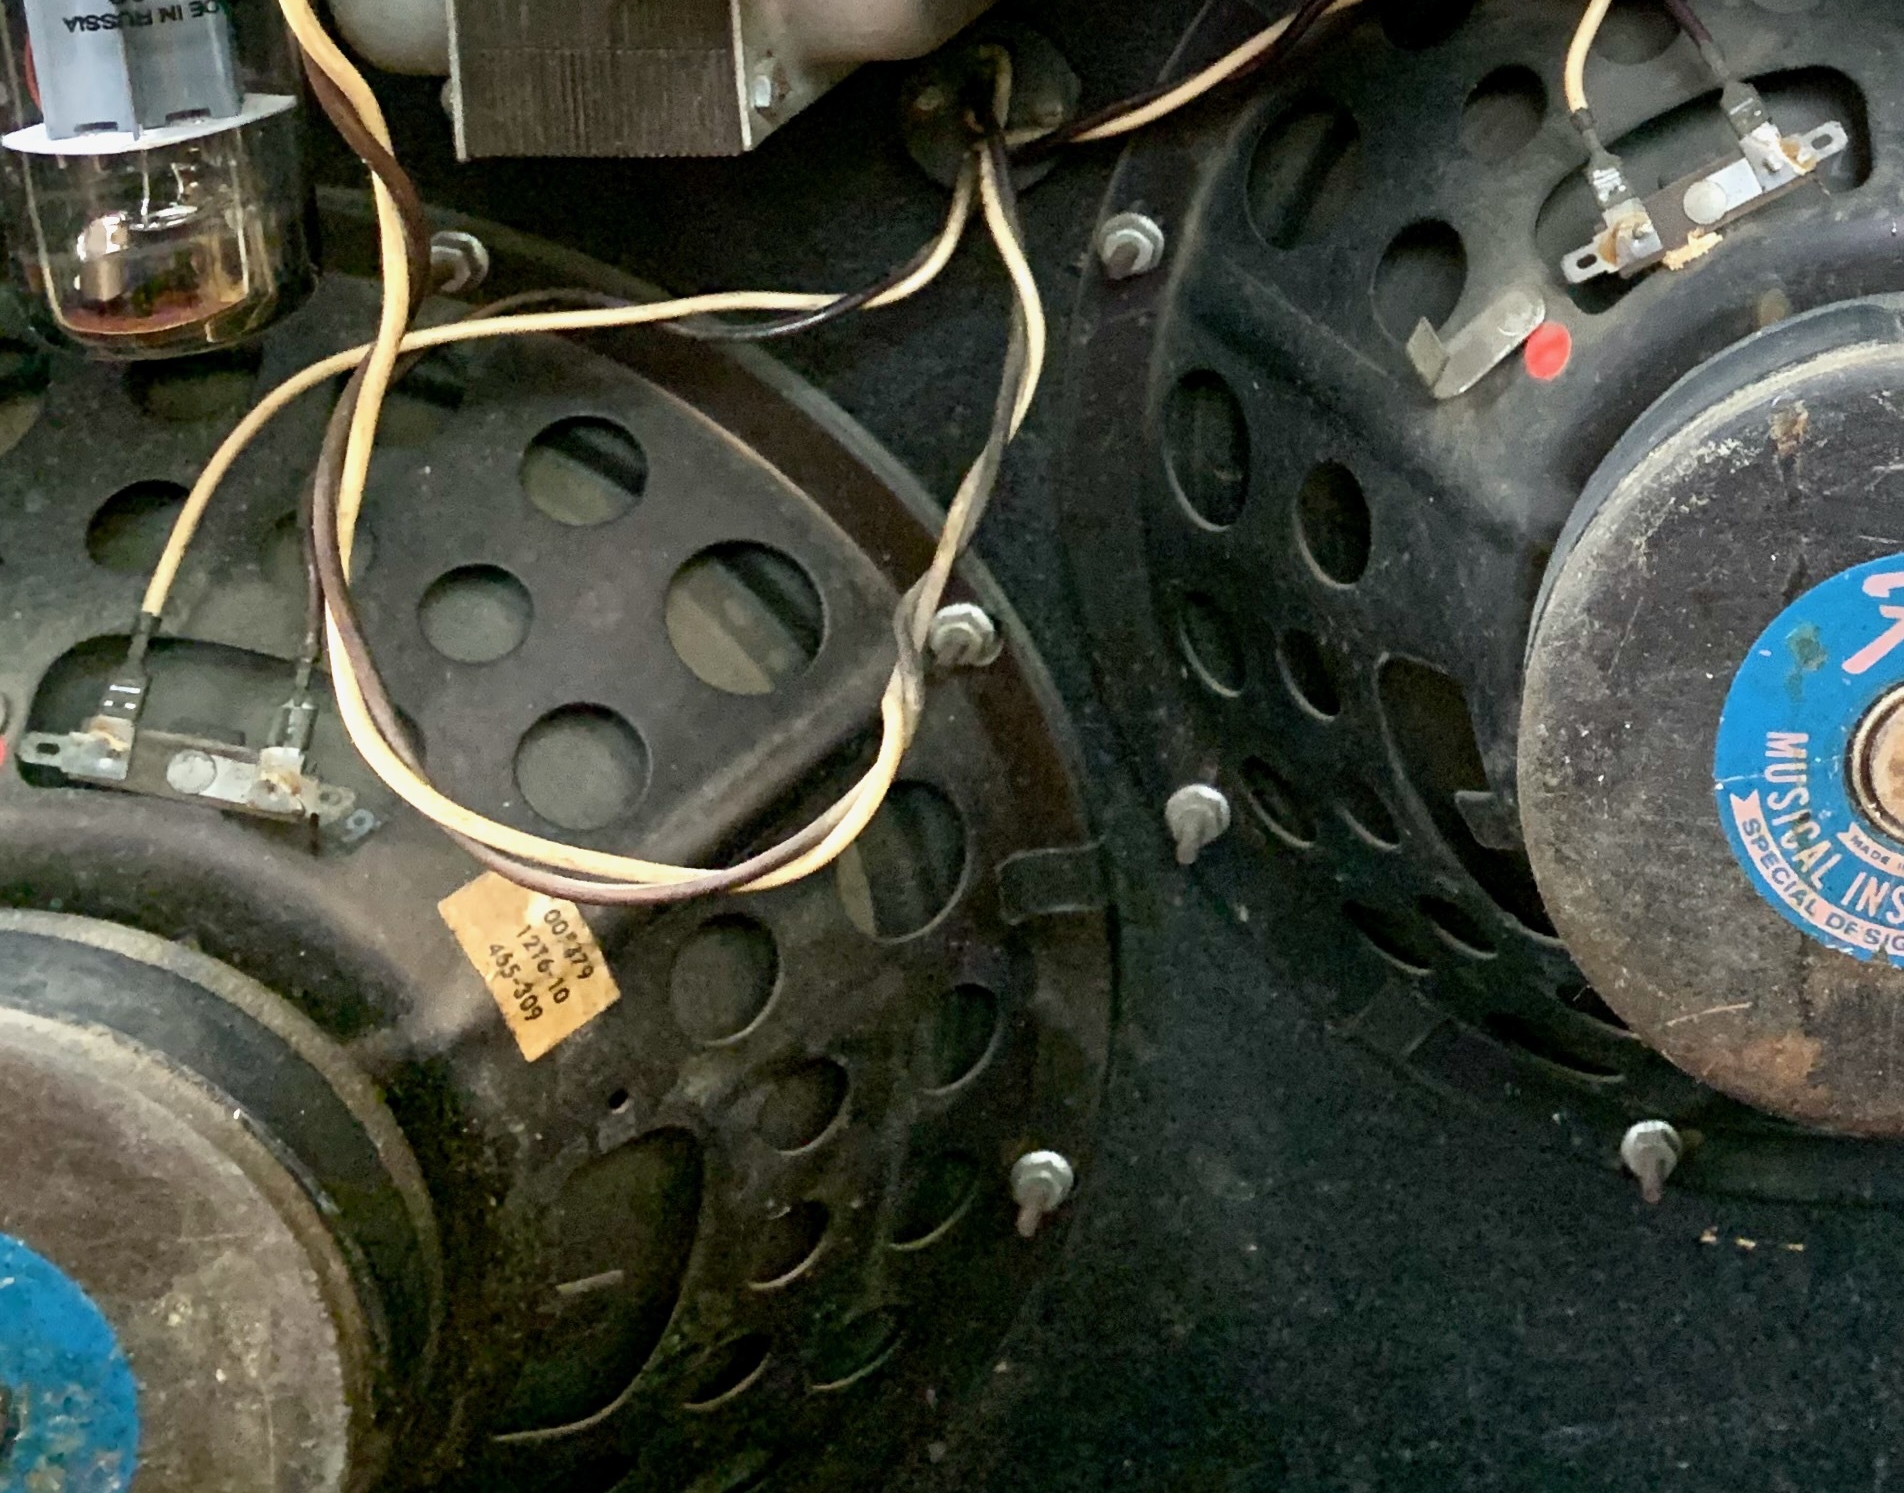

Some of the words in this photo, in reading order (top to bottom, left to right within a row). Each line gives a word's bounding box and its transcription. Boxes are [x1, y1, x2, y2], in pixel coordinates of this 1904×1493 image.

[62, 7, 154, 34] RUSSIA
[158, 4, 184, 24] IN
[1763, 730, 1845, 890] MUSICAL
[1740, 816, 1818, 918] SPECIAL
[1850, 834, 1891, 866] MADE
[488, 943, 544, 1022] 465-309
[515, 923, 571, 1004] 12T6-10
